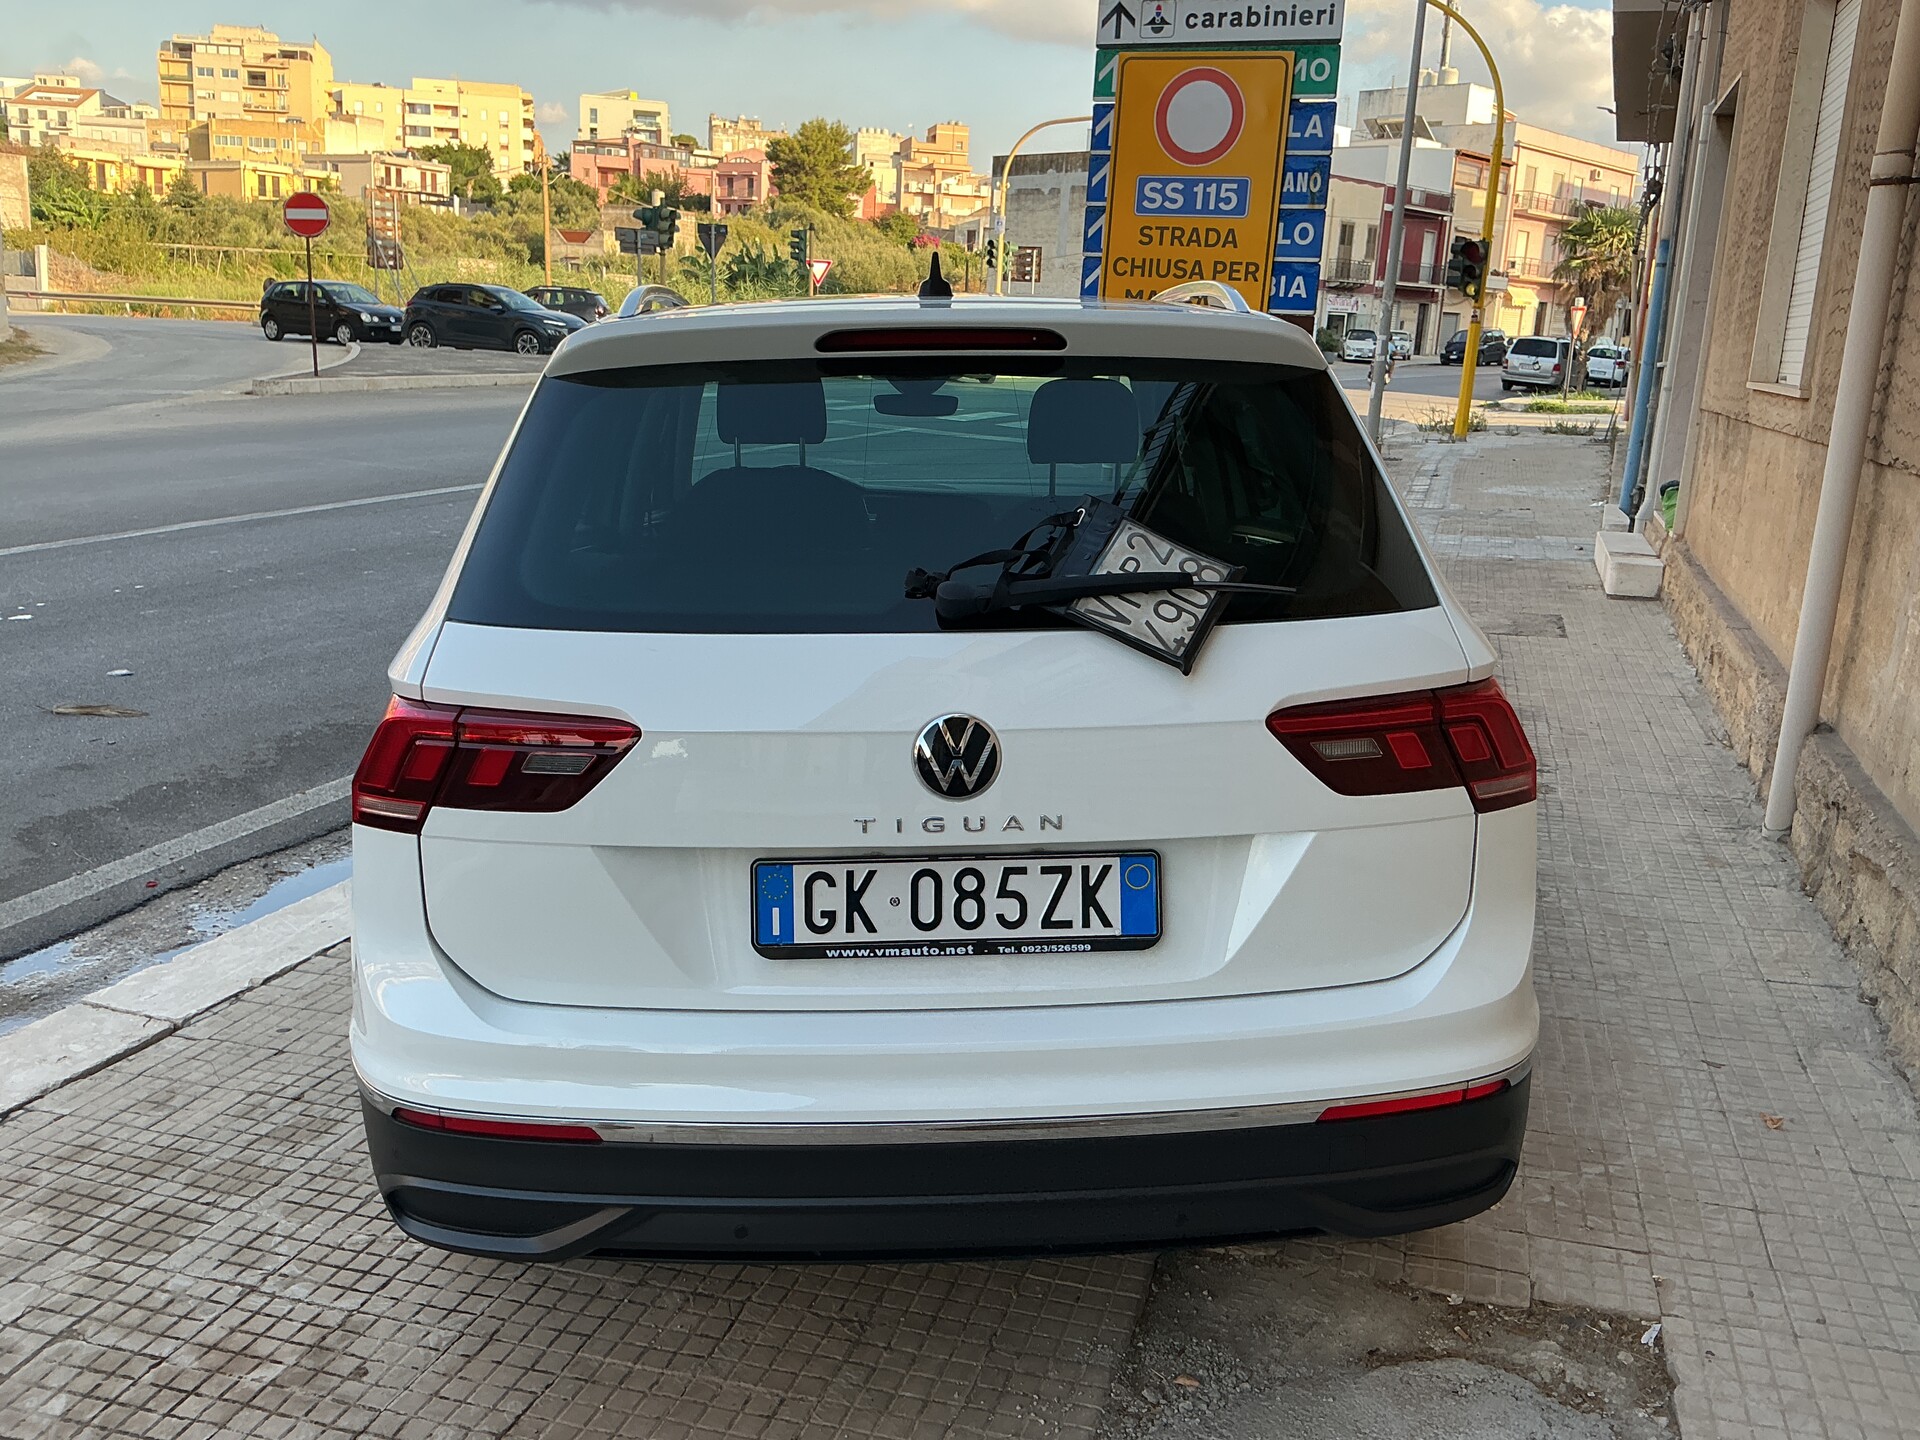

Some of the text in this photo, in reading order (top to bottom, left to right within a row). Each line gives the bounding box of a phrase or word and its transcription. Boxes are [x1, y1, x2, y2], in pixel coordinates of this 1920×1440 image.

[1184, 3, 1336, 29] carabinieri
[1288, 114, 1324, 138] LA
[1282, 172, 1321, 193] ANO
[1142, 181, 1238, 211] SS 115
[1138, 225, 1238, 248] STRADA
[1112, 256, 1260, 282] CHIUSA PER
[853, 814, 1064, 834] TIGUAN
[804, 869, 878, 935] GK
[910, 864, 1113, 933] 085ZK
[826, 943, 1092, 957] www.vmauto.net Tel. 0923/526599
